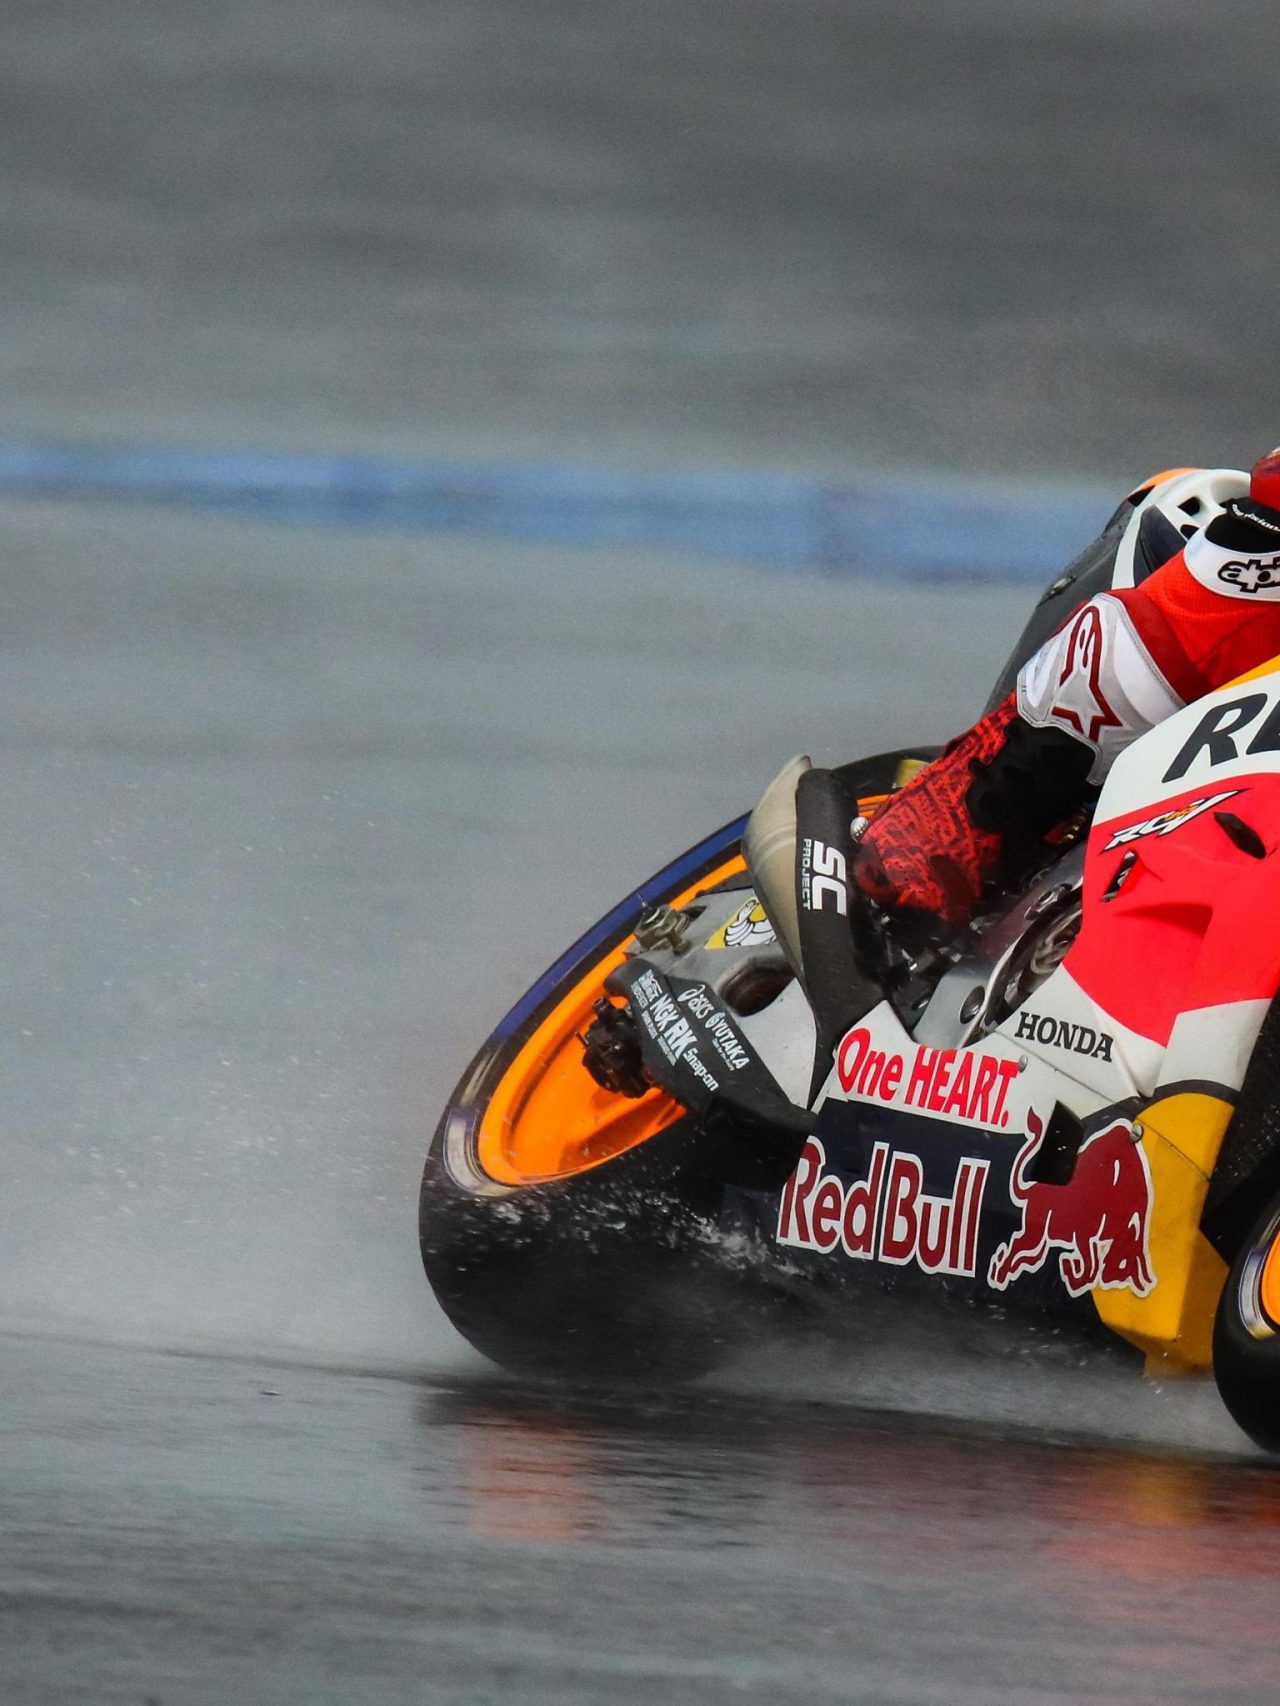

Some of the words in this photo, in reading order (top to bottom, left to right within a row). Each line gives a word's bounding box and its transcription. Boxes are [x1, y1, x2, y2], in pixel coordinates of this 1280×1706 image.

[802, 838, 812, 911] PROJECT
[812, 840, 847, 917] SC
[649, 993, 679, 1032] NGK
[663, 1017, 698, 1060] RK
[1014, 1010, 1115, 1063] HONDA
[837, 1028, 903, 1102] One
[904, 1045, 1020, 1128] HEART.
